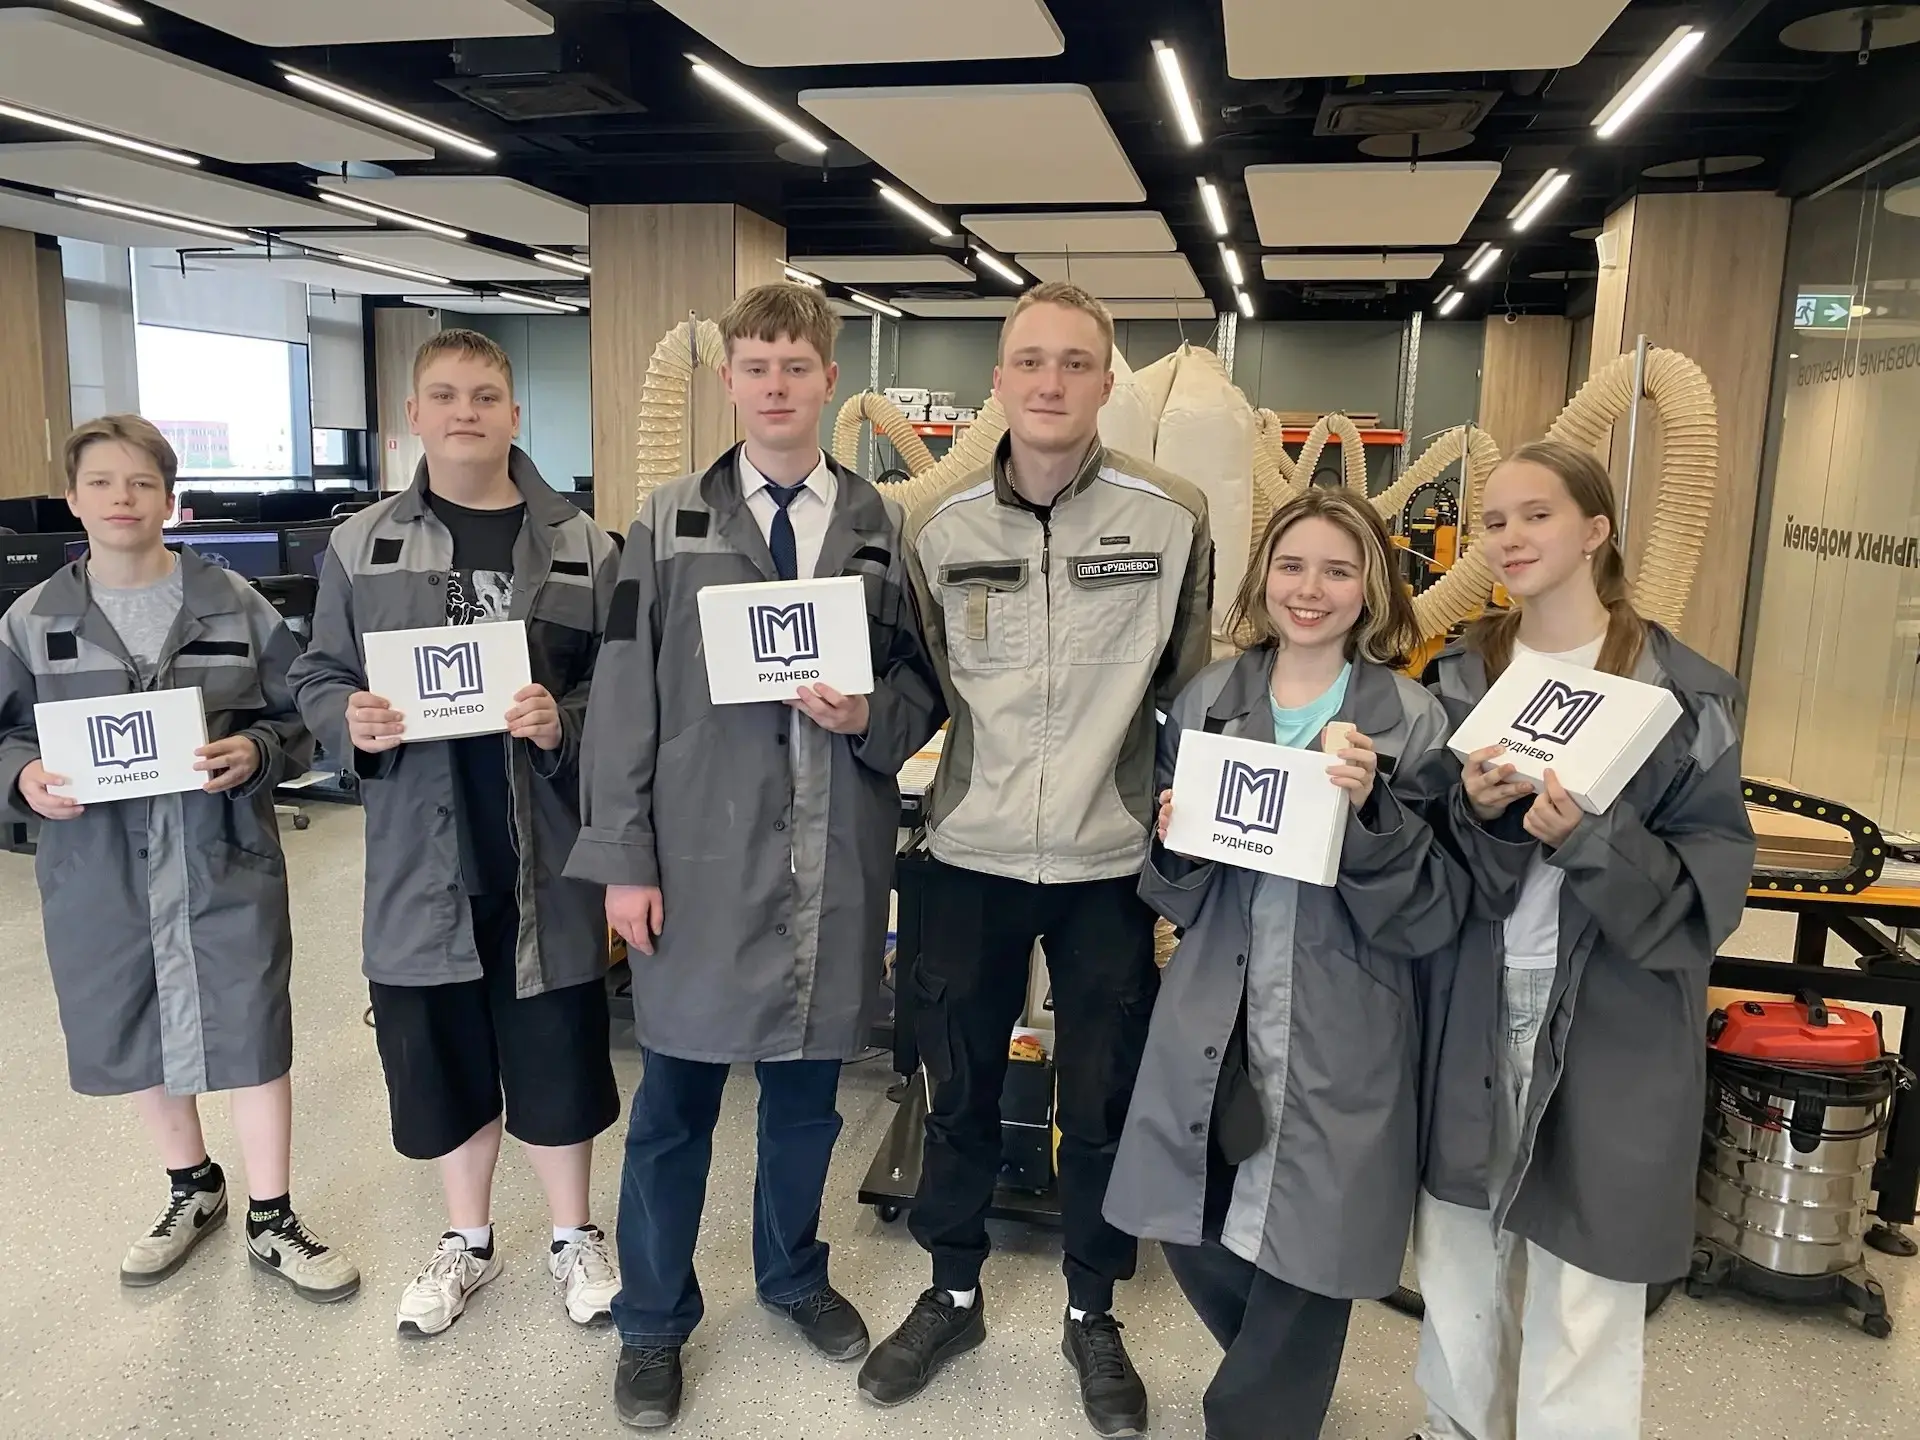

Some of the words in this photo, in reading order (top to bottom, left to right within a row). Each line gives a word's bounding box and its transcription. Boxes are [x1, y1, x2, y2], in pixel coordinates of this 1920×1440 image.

[1081, 564, 1101, 575] ППП
[1102, 561, 1154, 572] «РУДНЕВО»
[758, 669, 820, 683] РУДНЕВО
[423, 704, 485, 718] РУДНЕВО
[1498, 737, 1554, 762] РУДНЕВО
[98, 770, 159, 785] РУДНЕВО
[1212, 833, 1274, 855] РУДНЕВО
